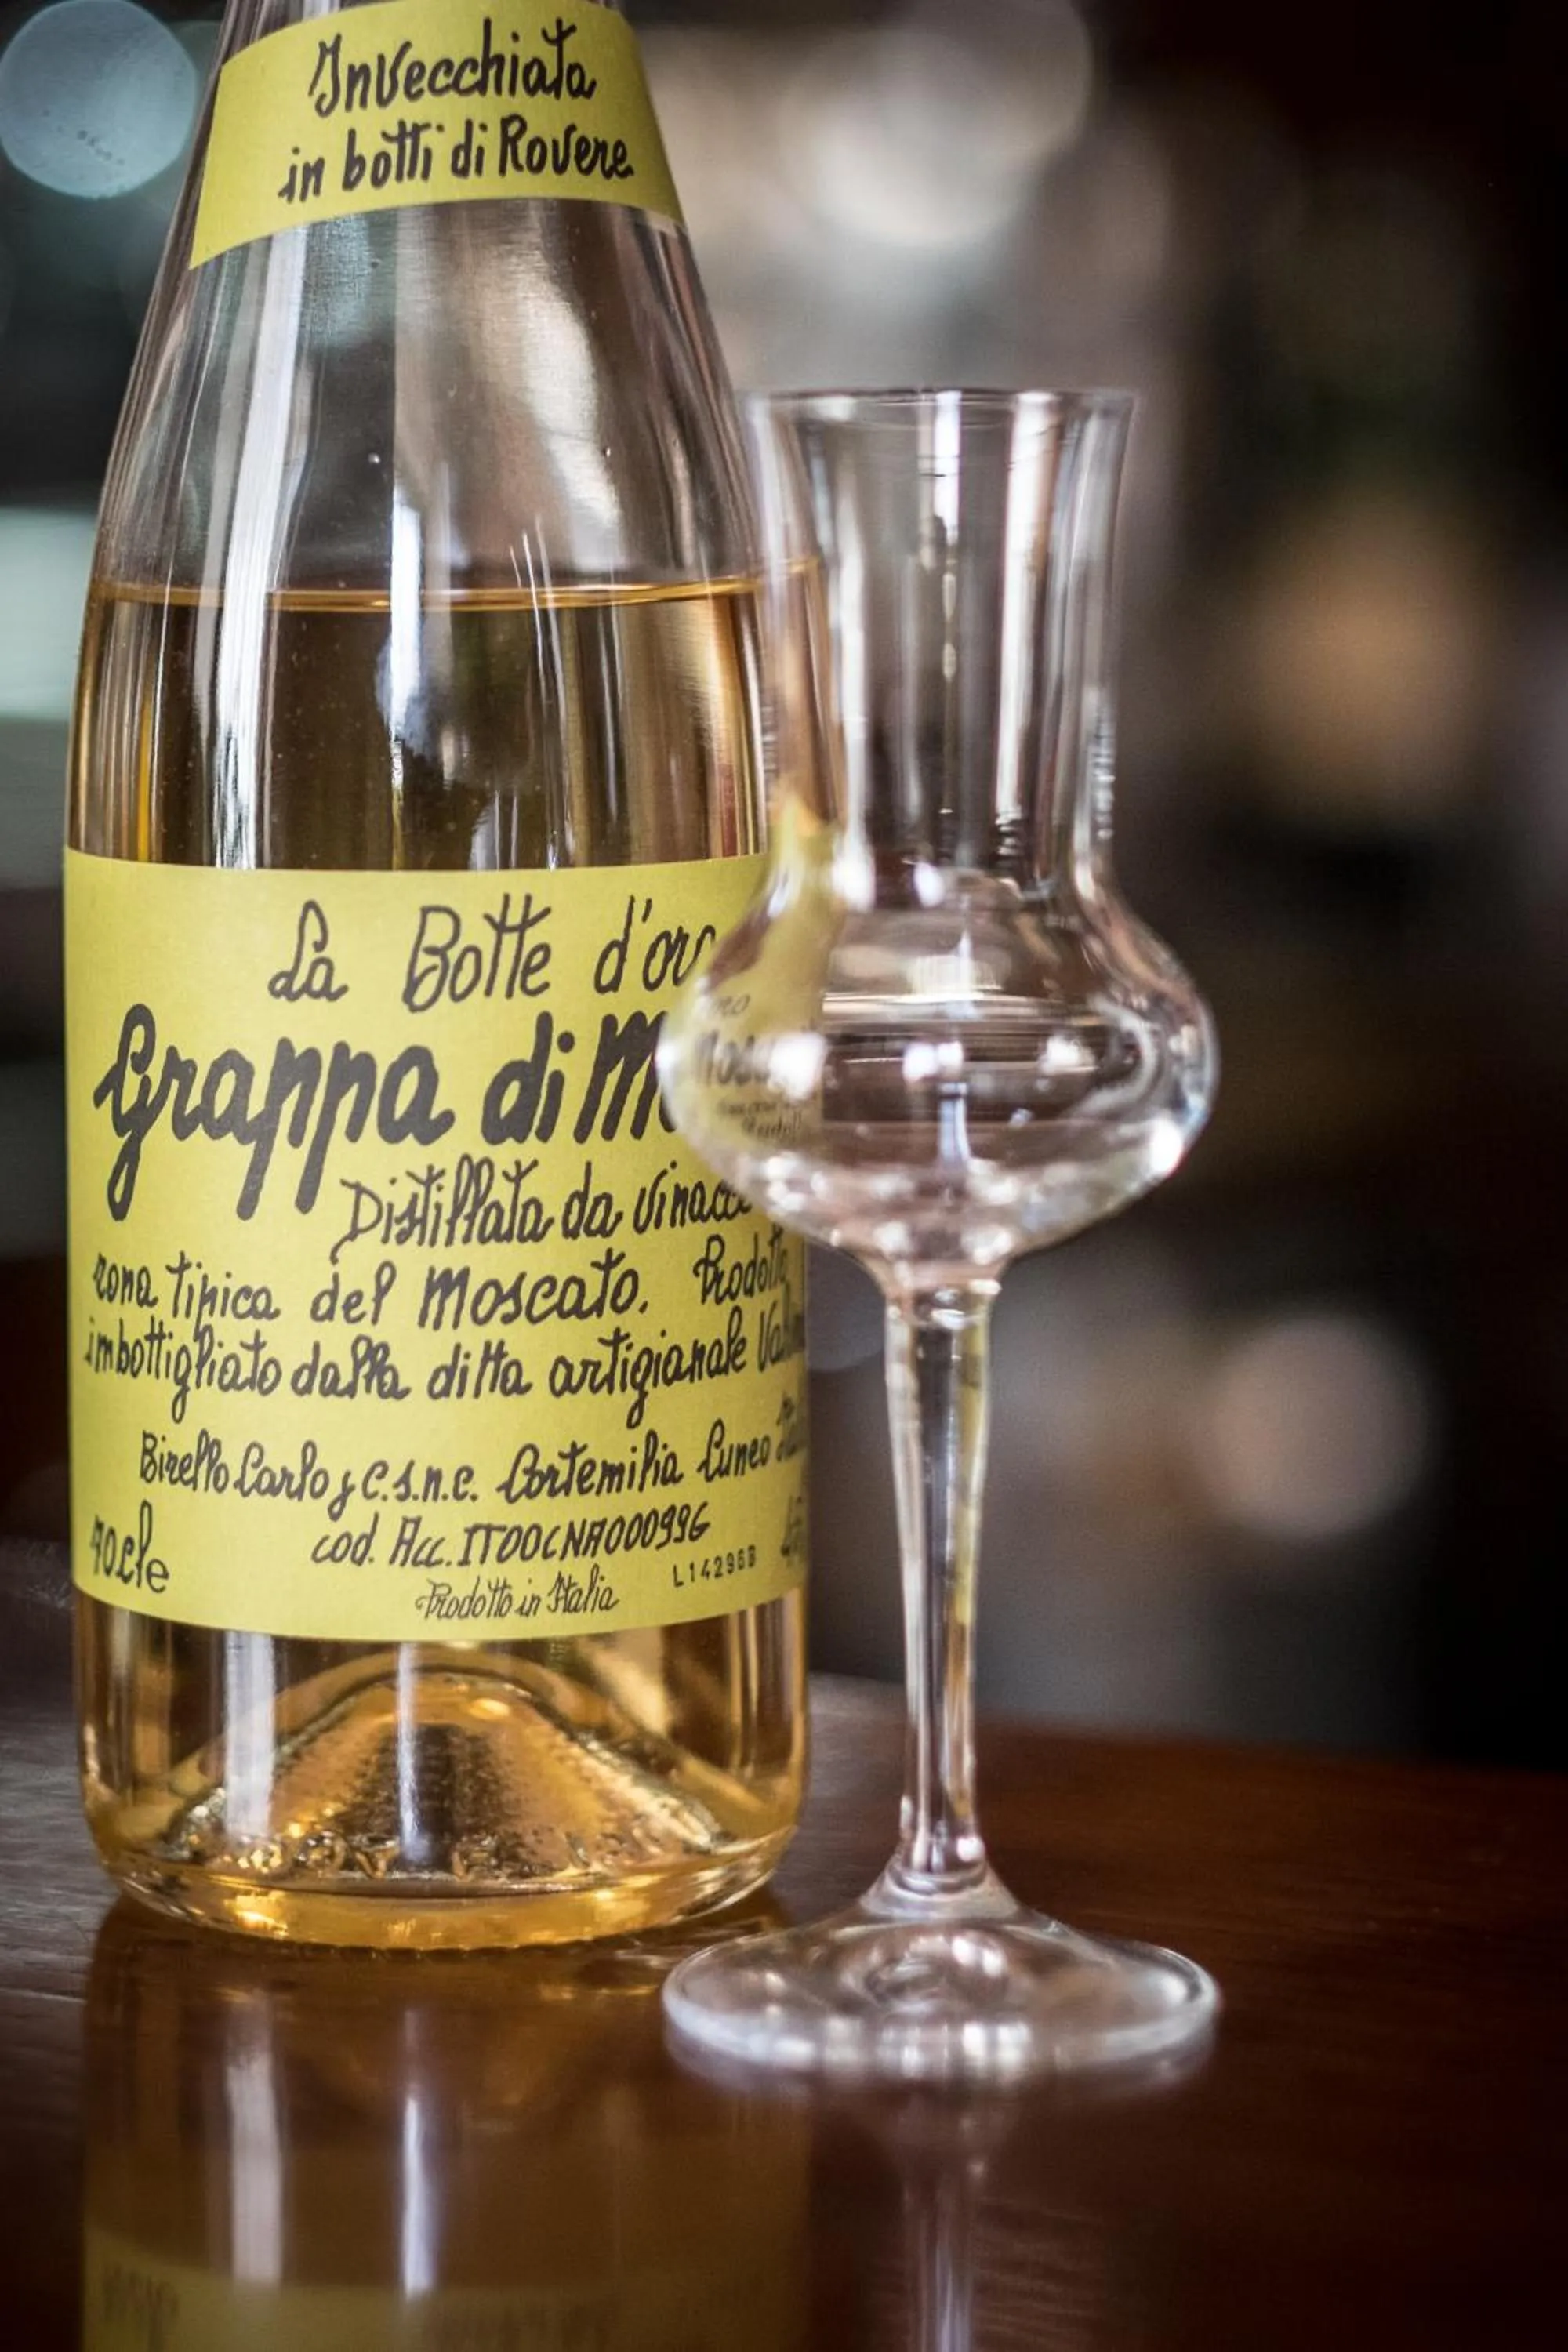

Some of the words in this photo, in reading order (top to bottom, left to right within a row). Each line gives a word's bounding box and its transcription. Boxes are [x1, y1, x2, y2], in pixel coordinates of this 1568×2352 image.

[308, 16, 597, 118] Invecchiata
[278, 147, 325, 202] in
[341, 121, 445, 191] botti
[450, 119, 488, 178] di
[499, 114, 634, 177] Rovere
[267, 901, 348, 1002] La
[401, 893, 552, 1014] Botte
[93, 1003, 455, 1221] Grappa
[481, 1010, 575, 1145] di
[329, 1153, 555, 1265] Distillata
[561, 1161, 624, 1241] da
[633, 1160, 753, 1235] vinacc
[165, 1250, 281, 1341] tipica
[310, 1259, 397, 1326] del
[418, 1247, 649, 1332] Moscato.
[84, 1314, 284, 1425] imbottigliato
[291, 1333, 412, 1400] dalla
[427, 1338, 533, 1400] ditta
[549, 1303, 747, 1430] artigianale
[139, 1428, 230, 1494] Birello
[233, 1439, 330, 1502] Carlo
[495, 1428, 685, 1505] Cortemilia
[696, 1417, 771, 1483] Cuneo
[310, 1511, 379, 1567] cod.
[415, 1574, 514, 1621] Prodotto
[515, 1577, 542, 1617] in
[546, 1563, 620, 1614] Italia
